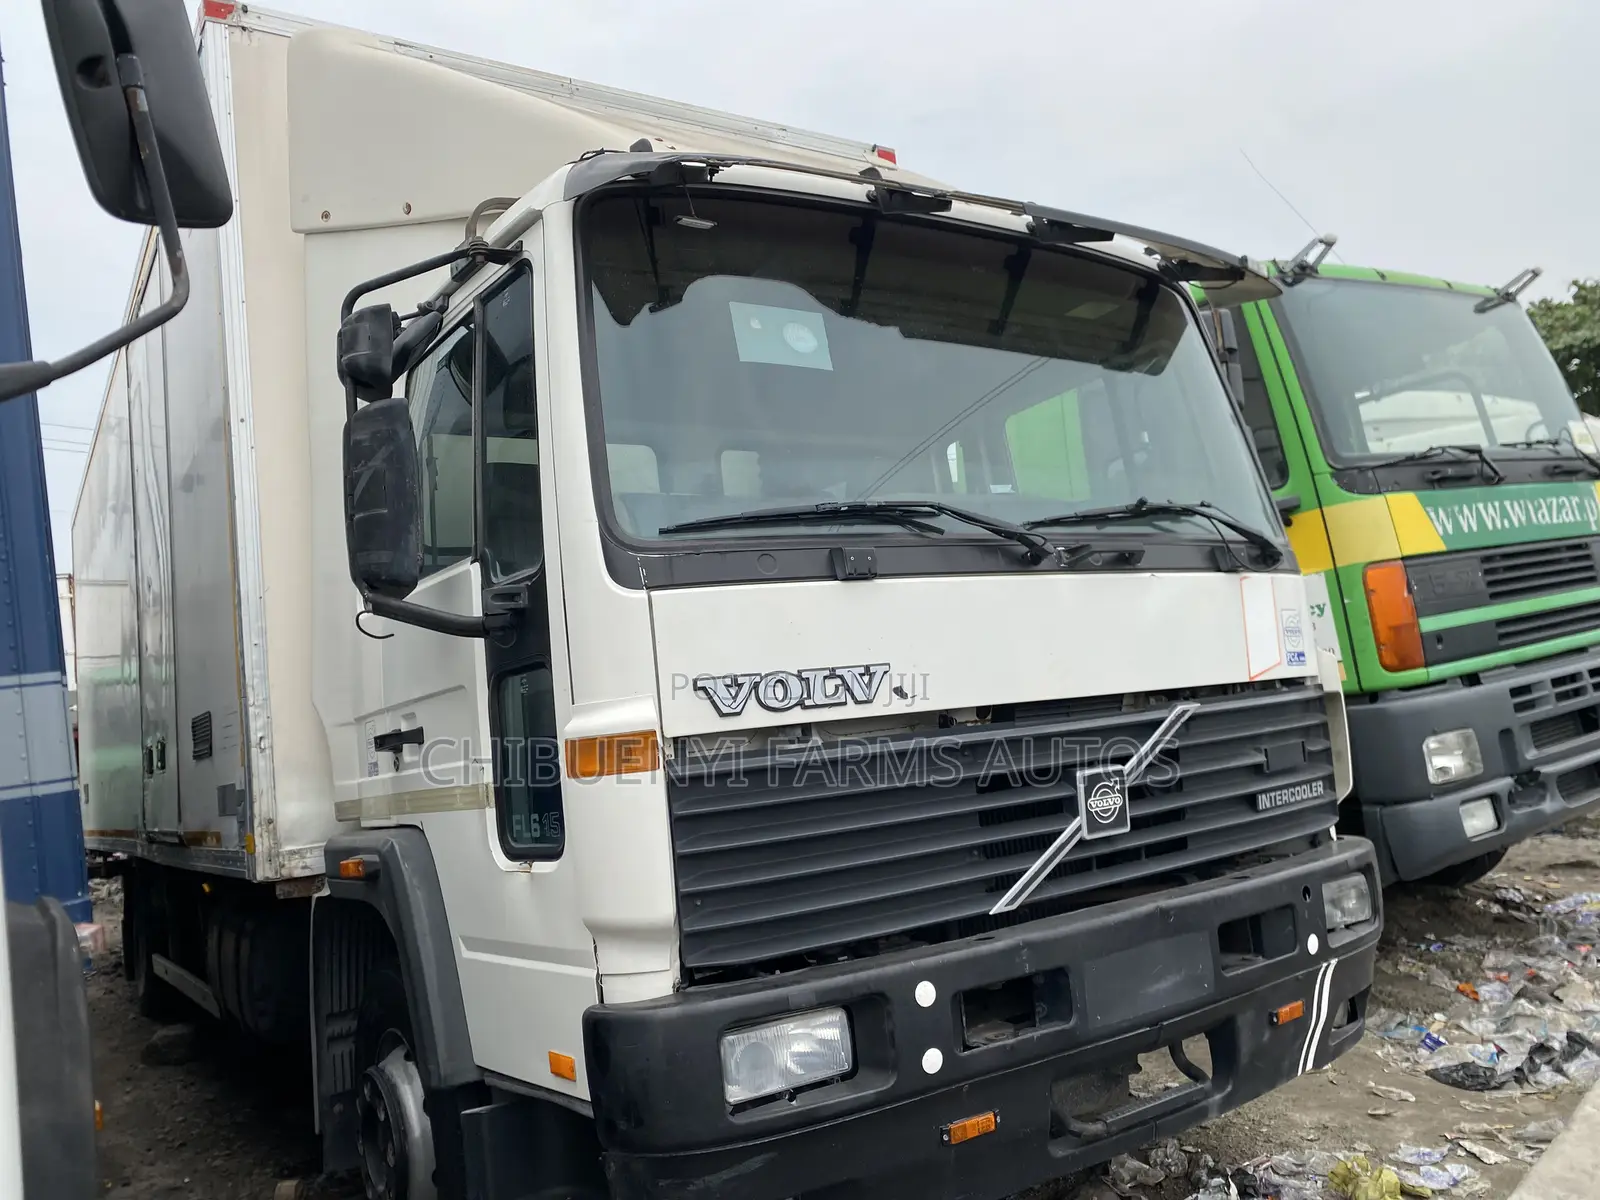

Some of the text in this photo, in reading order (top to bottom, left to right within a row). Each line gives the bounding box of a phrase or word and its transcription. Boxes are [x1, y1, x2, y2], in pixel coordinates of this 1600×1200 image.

[1090, 796, 1121, 809] VOLVO
[1258, 780, 1324, 810] INTERCOOLER
[512, 813, 540, 838] FL6
